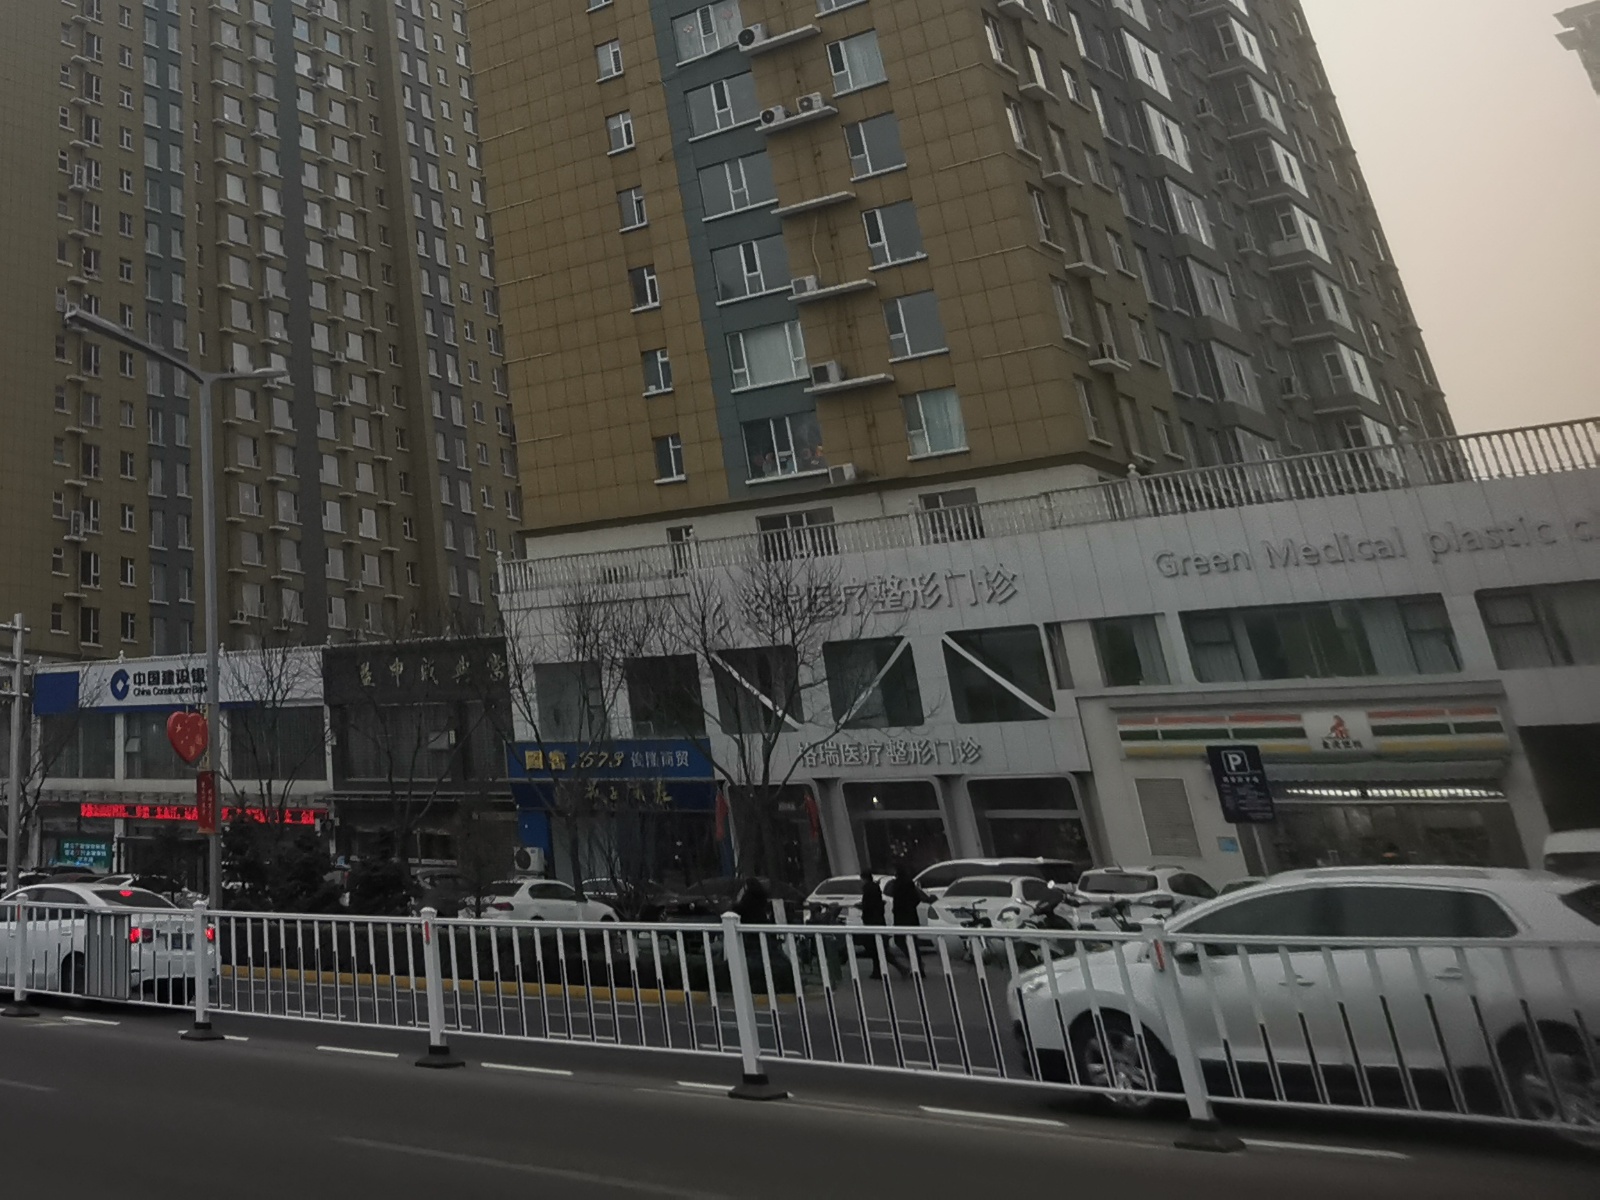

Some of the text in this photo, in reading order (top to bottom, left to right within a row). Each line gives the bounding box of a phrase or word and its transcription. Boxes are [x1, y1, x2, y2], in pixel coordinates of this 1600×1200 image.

[1154, 549, 1250, 578] Green
[1262, 527, 1407, 570] Medical
[1424, 516, 1557, 564] plastic
[133, 667, 208, 686] 中国建设银
[133, 688, 152, 697] China
[152, 686, 191, 697] Construction
[797, 736, 982, 767] 格瑞医疗整形门诊
[1227, 753, 1242, 772] P
